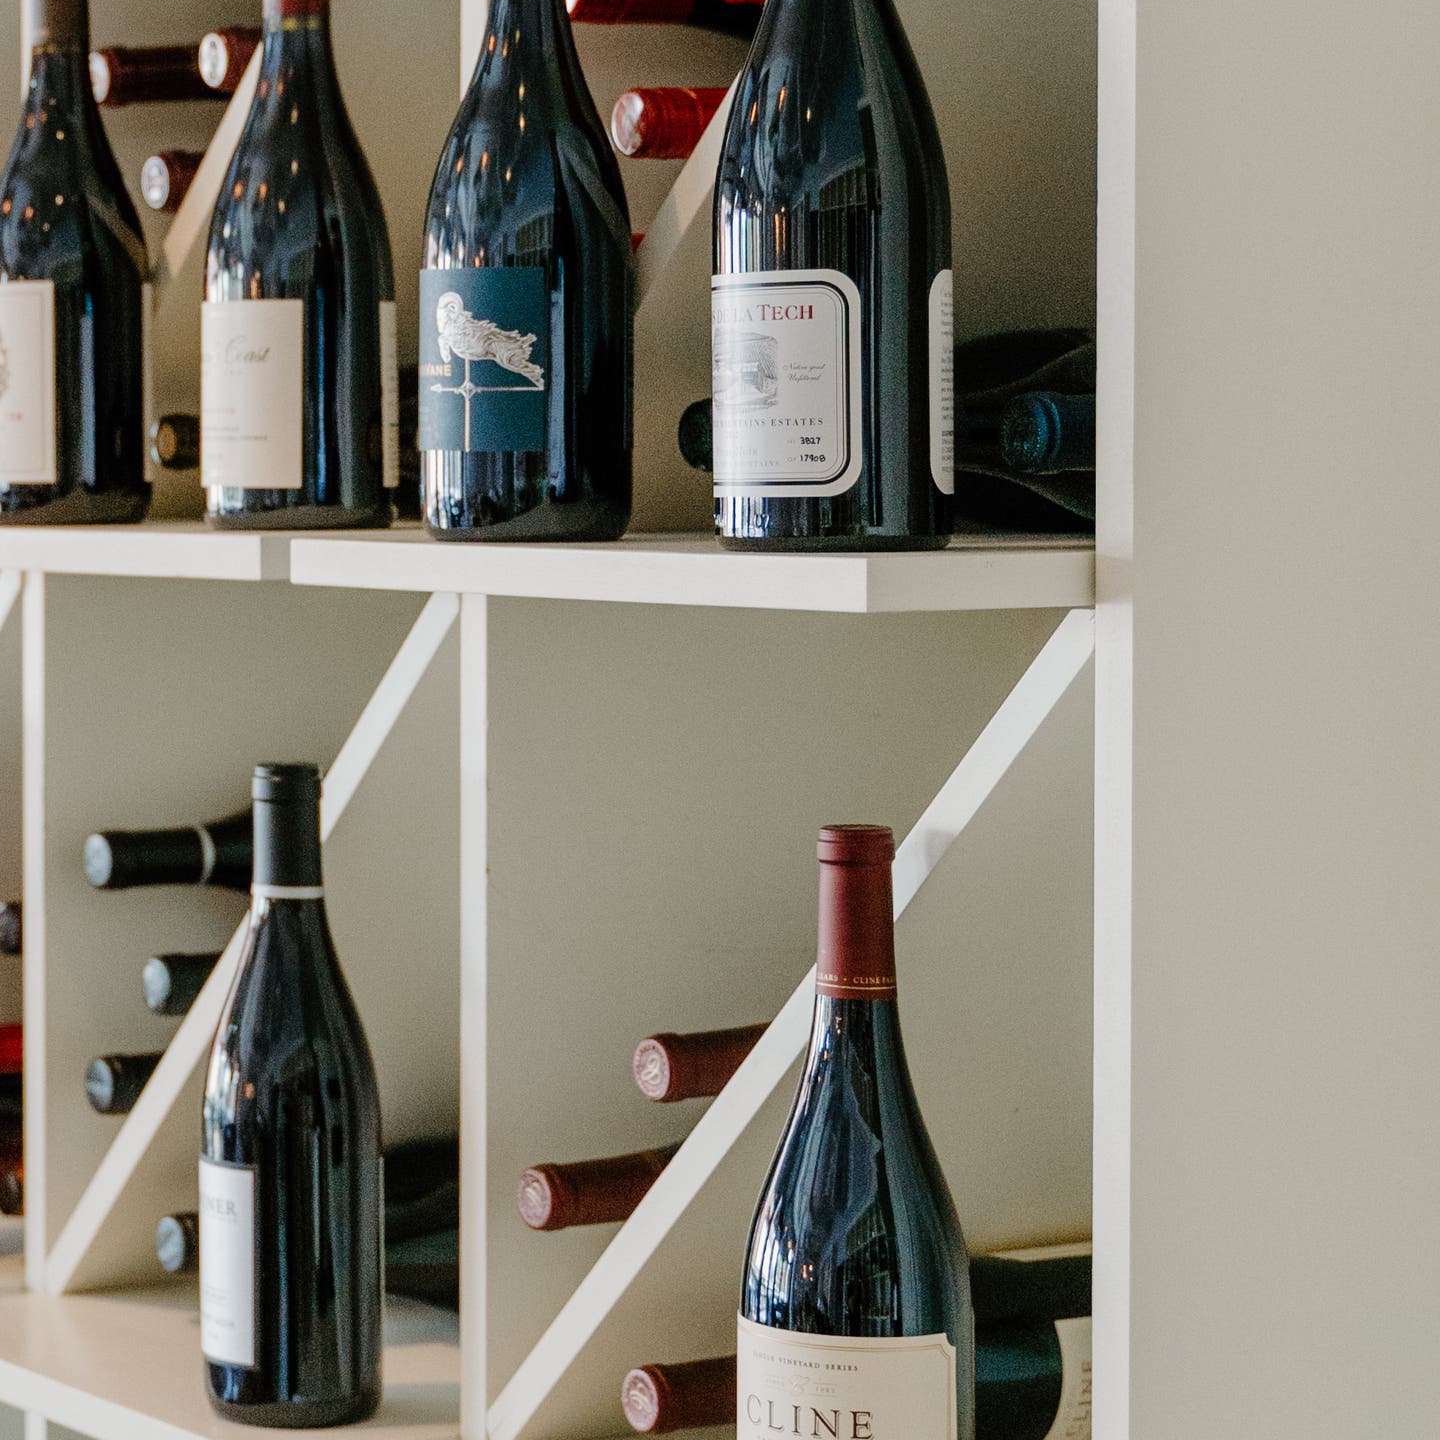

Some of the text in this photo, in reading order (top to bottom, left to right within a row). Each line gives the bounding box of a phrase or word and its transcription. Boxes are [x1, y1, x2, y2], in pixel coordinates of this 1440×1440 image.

[757, 304, 814, 321] TECH
[770, 417, 824, 427] ESTATES
[853, 975, 881, 985] CLINE
[778, 1358, 820, 1370] VINEYARD
[825, 1363, 858, 1372] SERIES
[747, 1394, 875, 1440] CLINE
